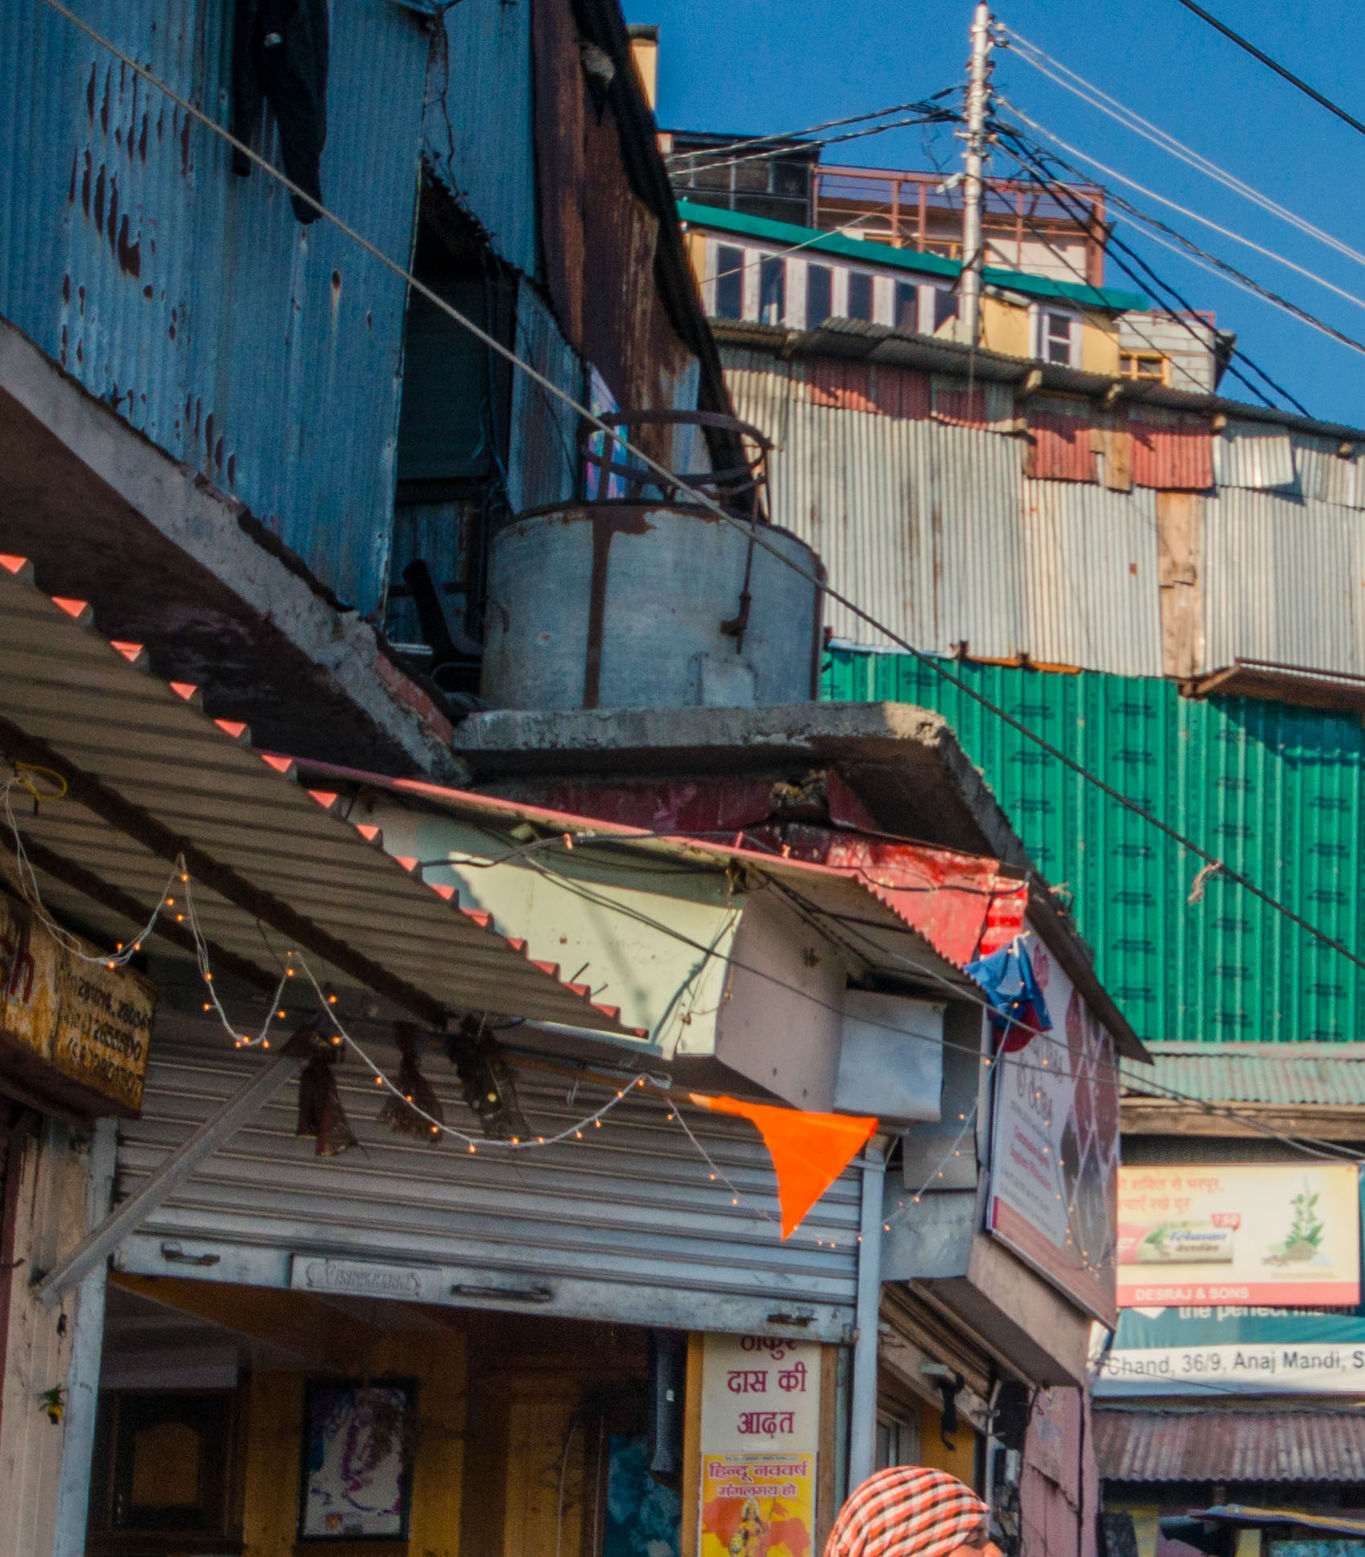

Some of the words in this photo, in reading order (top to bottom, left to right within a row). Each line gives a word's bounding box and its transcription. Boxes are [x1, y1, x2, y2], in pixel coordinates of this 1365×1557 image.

[1135, 1289, 1191, 1300] DESRAJ
[1196, 1288, 1206, 1299] &
[1209, 1287, 1249, 1299] SONS
[1233, 1351, 1275, 1373] Anaj
[1283, 1351, 1346, 1372] Mandi,
[727, 1369, 768, 1394] दास
[778, 1361, 807, 1392] की
